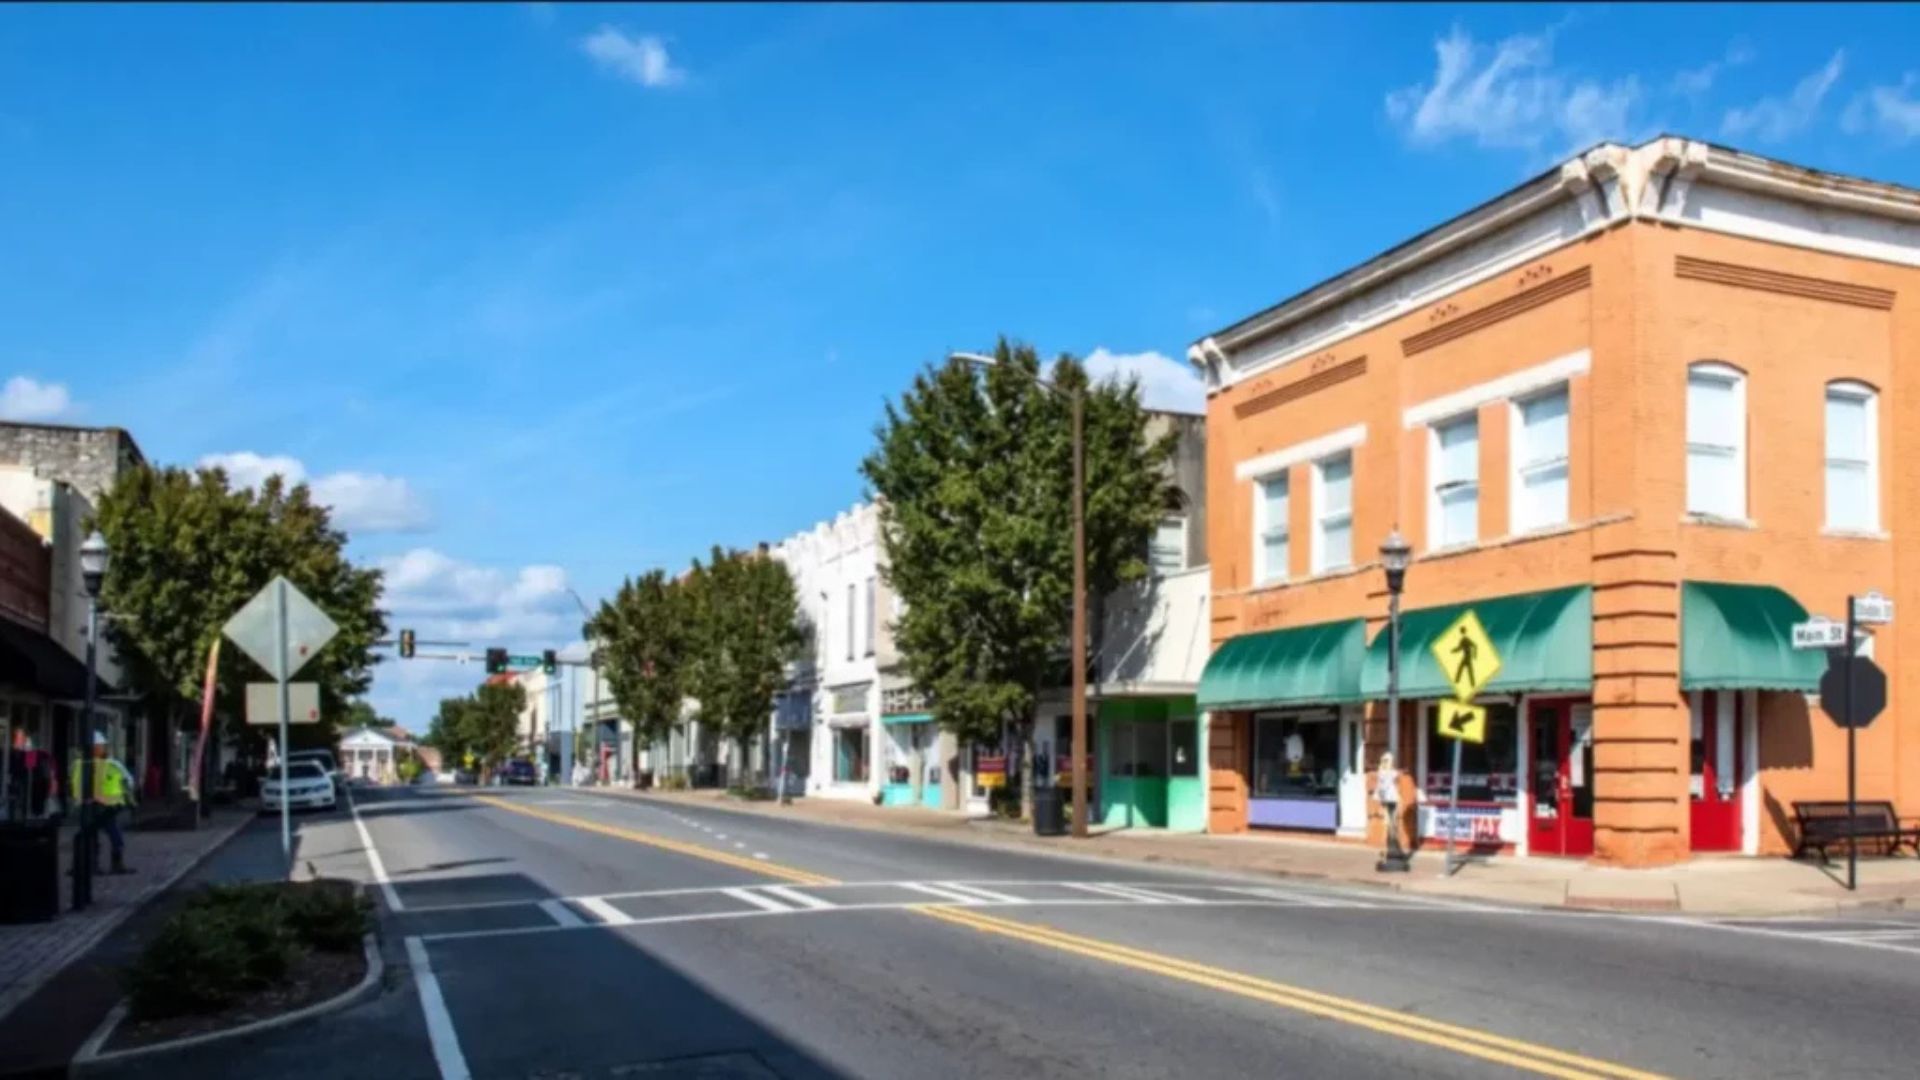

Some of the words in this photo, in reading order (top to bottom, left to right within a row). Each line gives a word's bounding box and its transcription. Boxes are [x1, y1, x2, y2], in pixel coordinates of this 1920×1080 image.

[1796, 630, 1824, 642] Main
[1829, 626, 1842, 640] St
[1473, 817, 1501, 838] TAX
